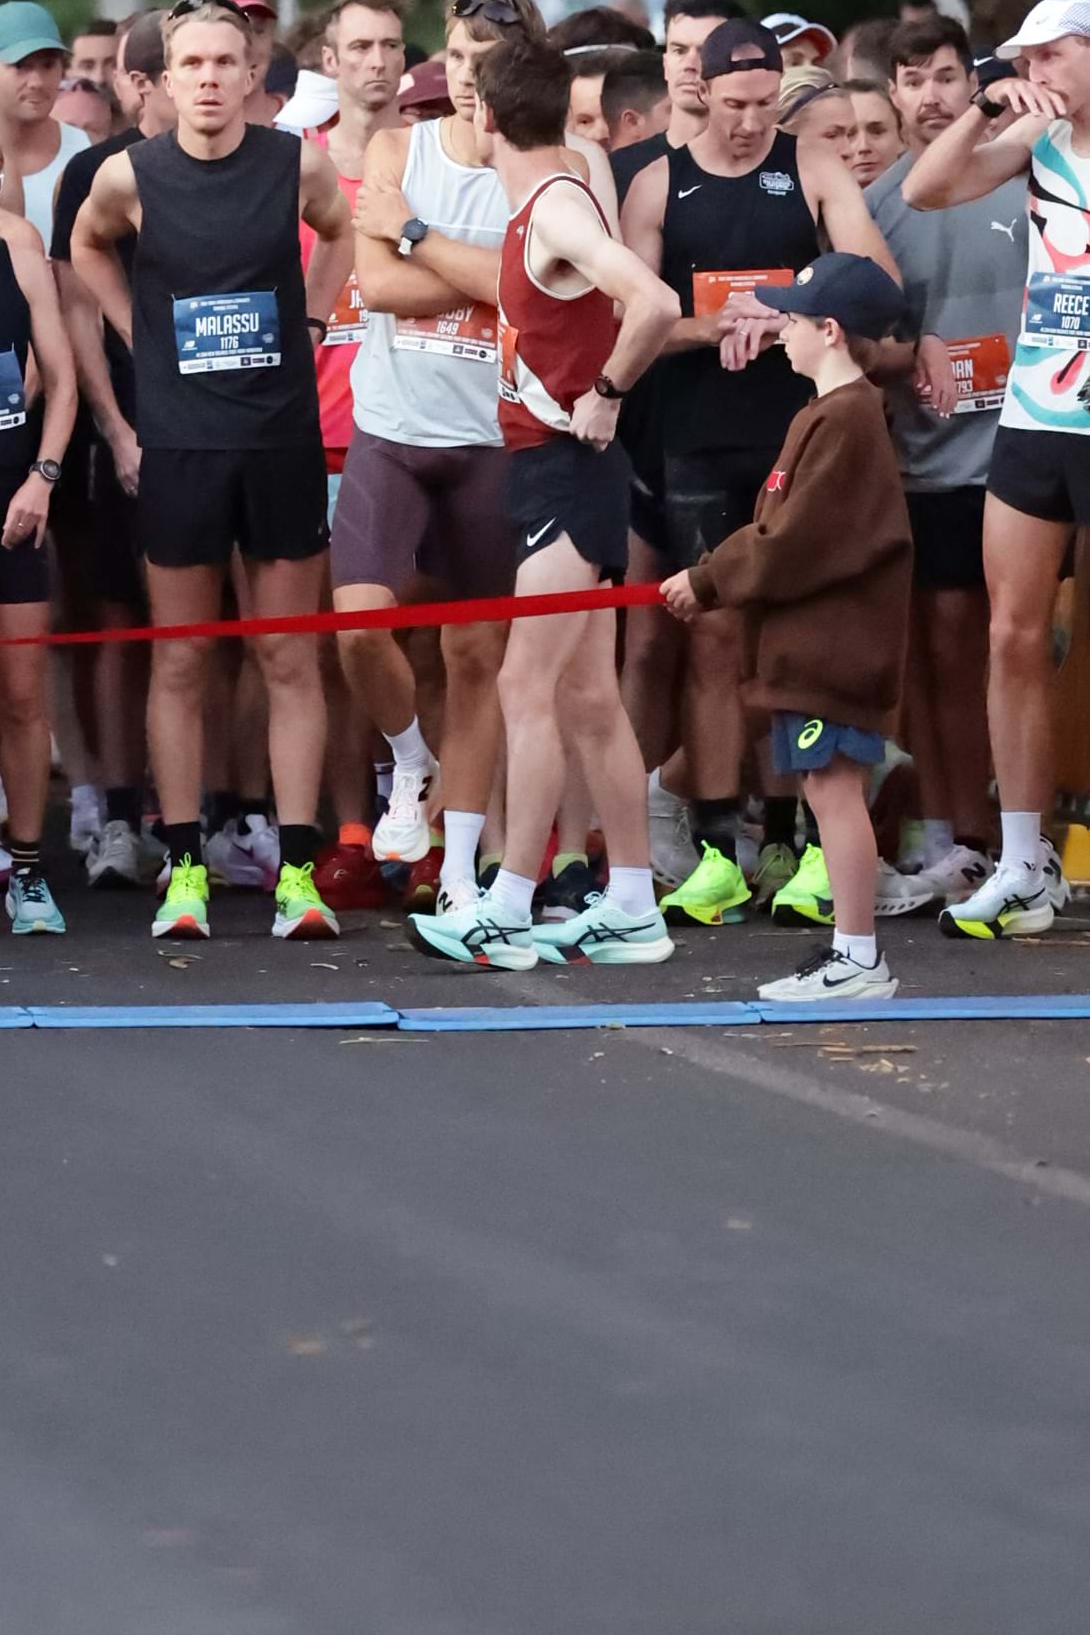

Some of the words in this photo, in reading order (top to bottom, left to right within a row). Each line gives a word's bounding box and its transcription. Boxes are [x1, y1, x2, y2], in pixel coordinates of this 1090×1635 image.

[1053, 292, 1090, 315] REECE
[195, 312, 260, 338] MALASSU
[436, 320, 460, 336] 1649
[1061, 316, 1081, 330] 1070
[220, 335, 239, 350] 1176
